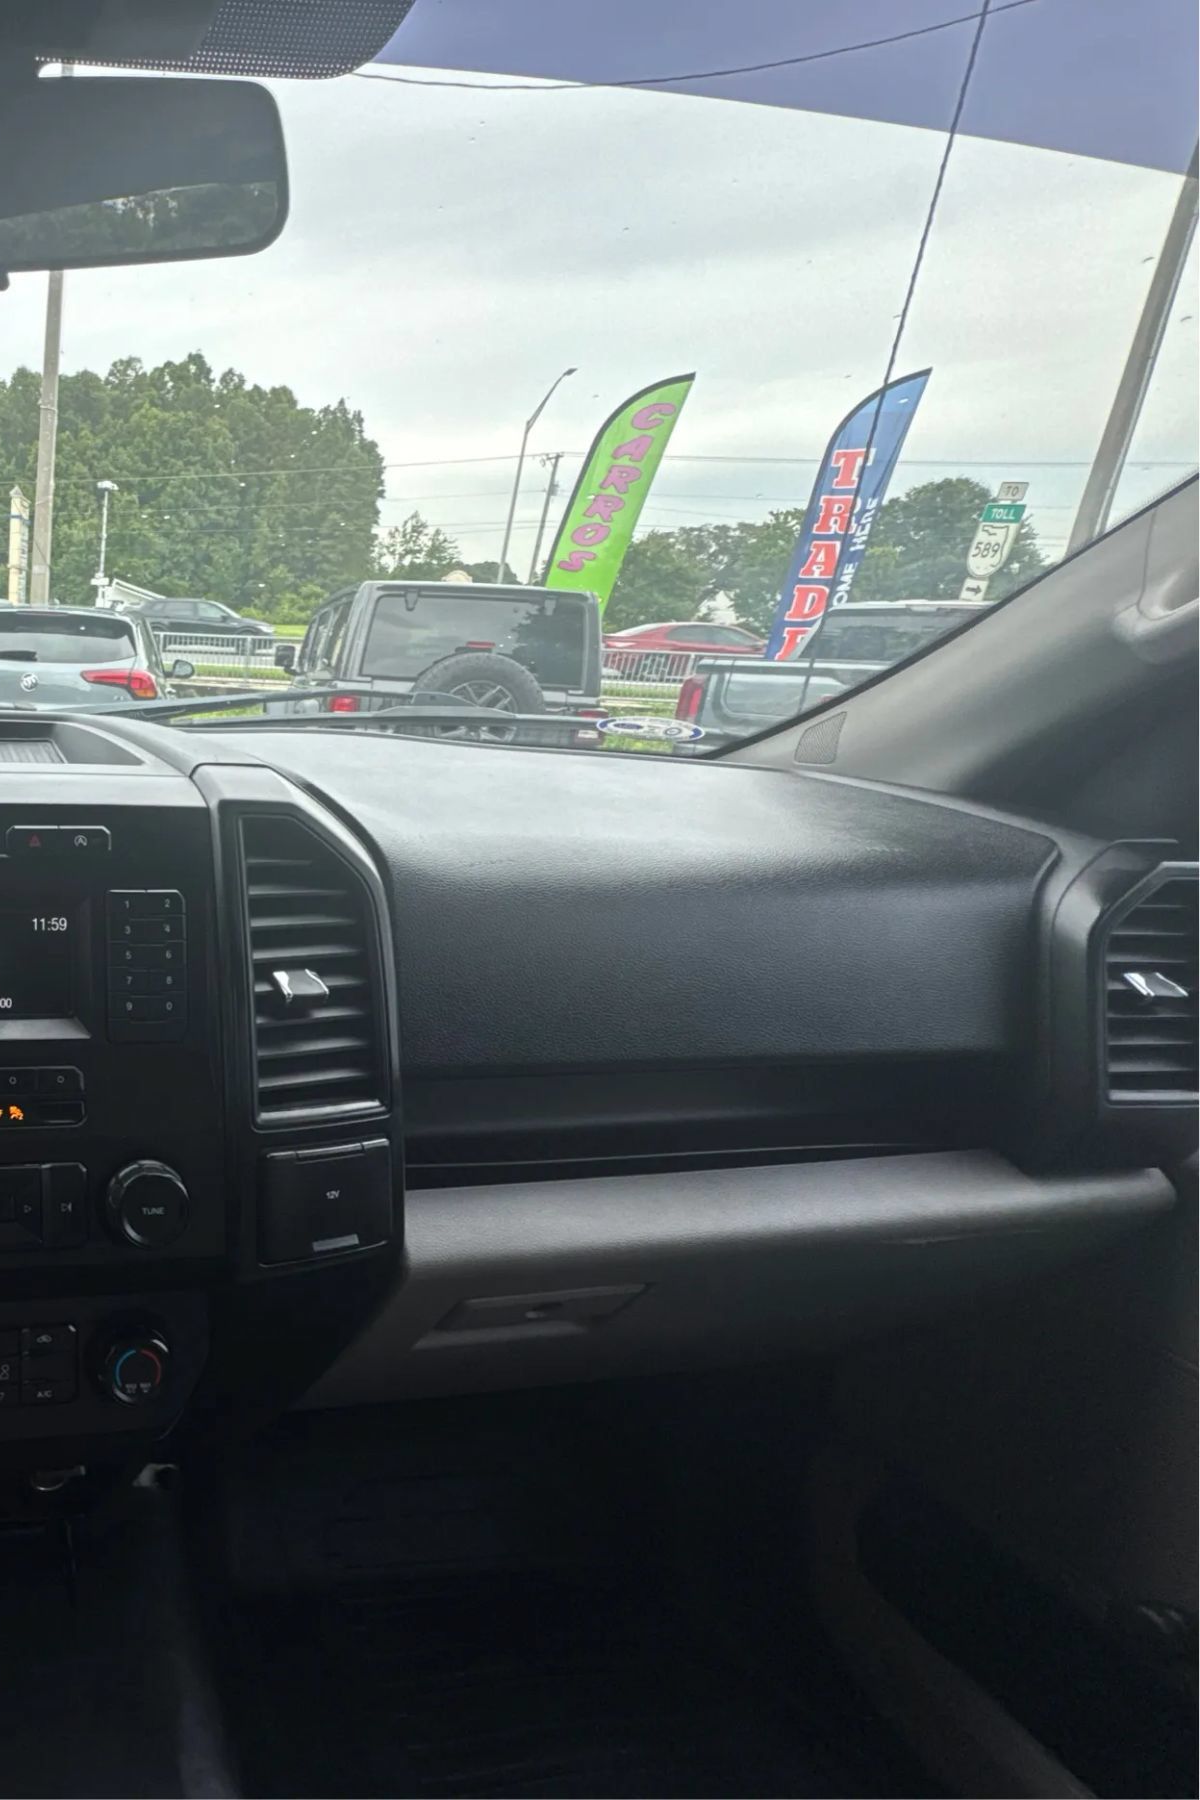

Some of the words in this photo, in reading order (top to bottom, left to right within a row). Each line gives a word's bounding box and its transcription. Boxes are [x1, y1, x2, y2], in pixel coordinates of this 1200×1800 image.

[557, 402, 677, 573] CARROS
[1006, 486, 1019, 497] TO
[991, 508, 1016, 520] TOLL
[833, 561, 859, 606] OME
[850, 496, 878, 552] HERE
[972, 541, 1000, 559] 589
[31, 917, 68, 932] 11:59
[166, 1001, 173, 1011] 0
[326, 1188, 340, 1199] 12V
[141, 1207, 165, 1216] TUNE
[37, 1390, 53, 1398] A/C
